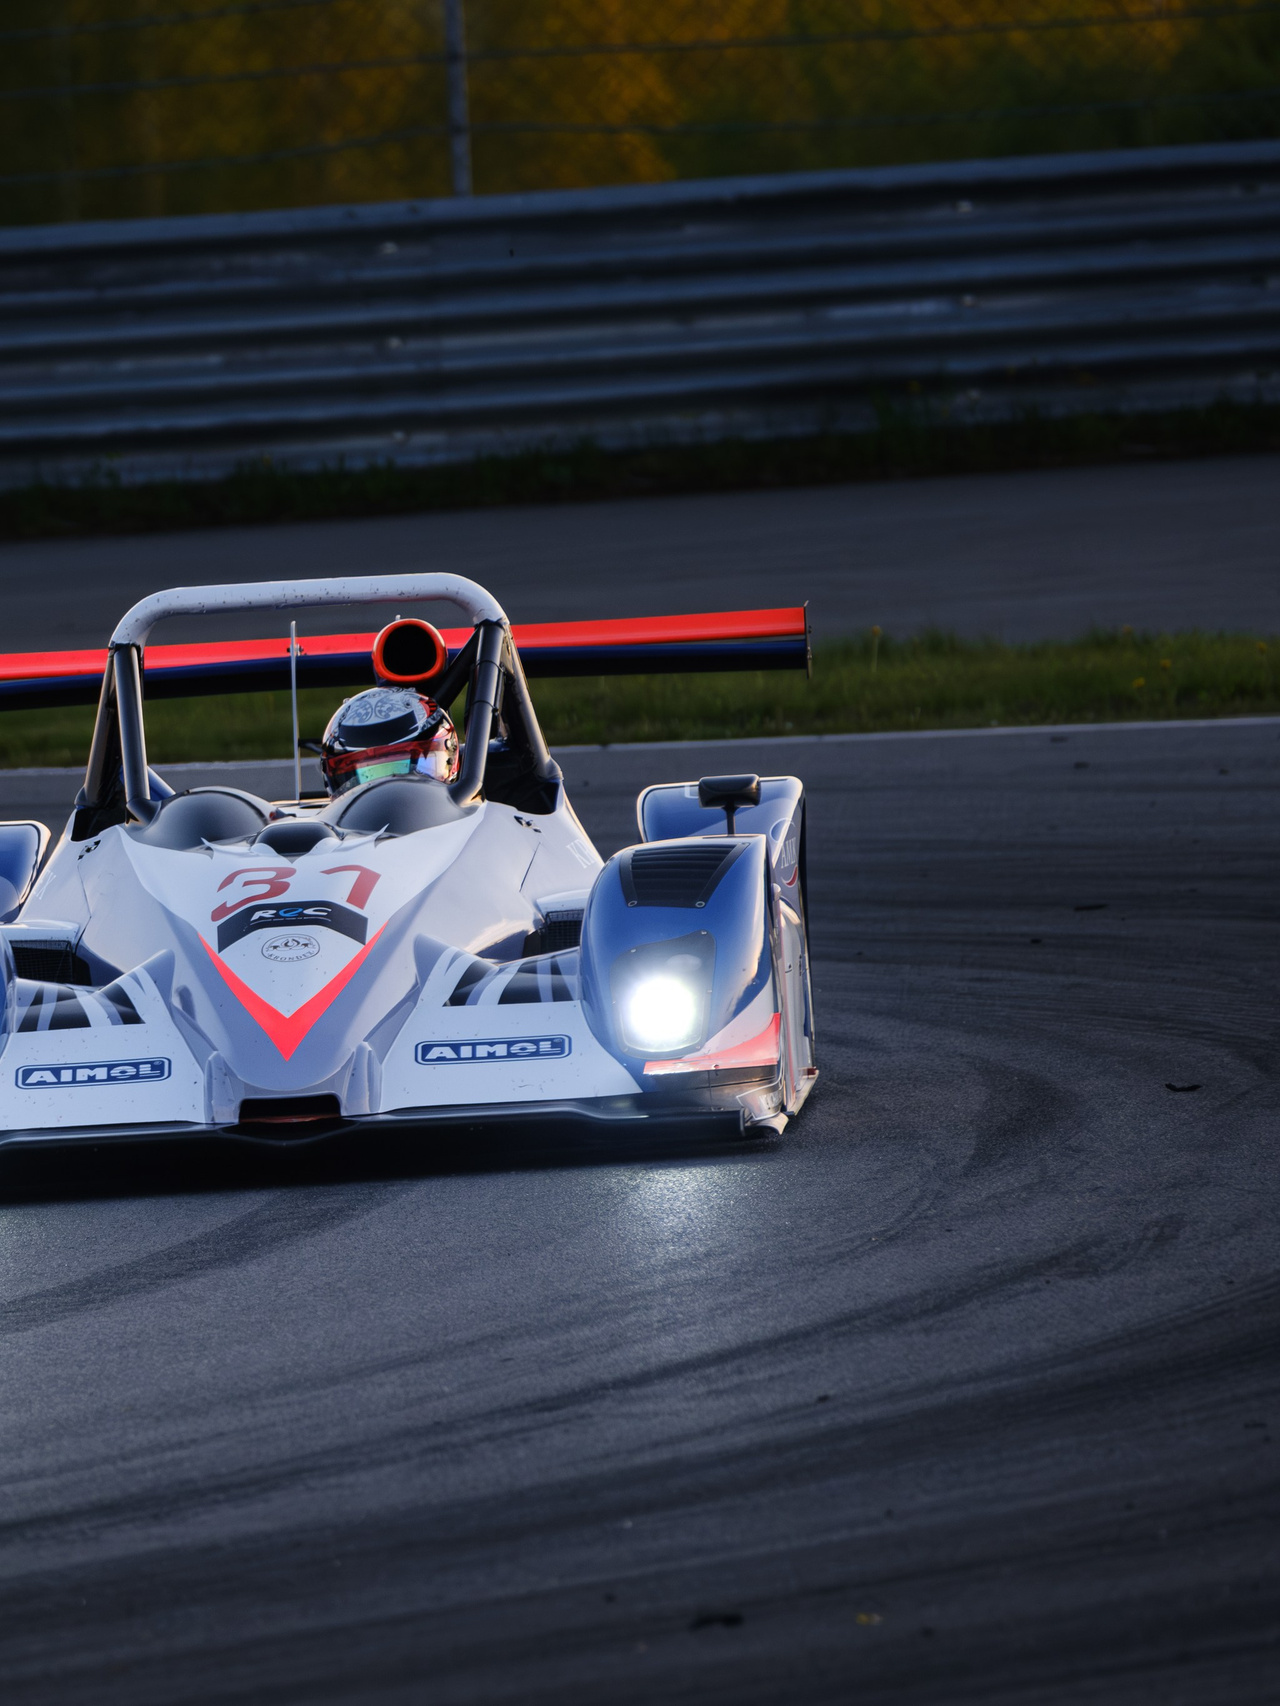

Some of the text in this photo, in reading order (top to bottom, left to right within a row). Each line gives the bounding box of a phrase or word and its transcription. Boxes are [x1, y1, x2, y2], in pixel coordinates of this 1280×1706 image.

[211, 864, 382, 922] 31
[424, 1040, 562, 1060] AIMOL
[24, 1063, 161, 1084] AIMOL
